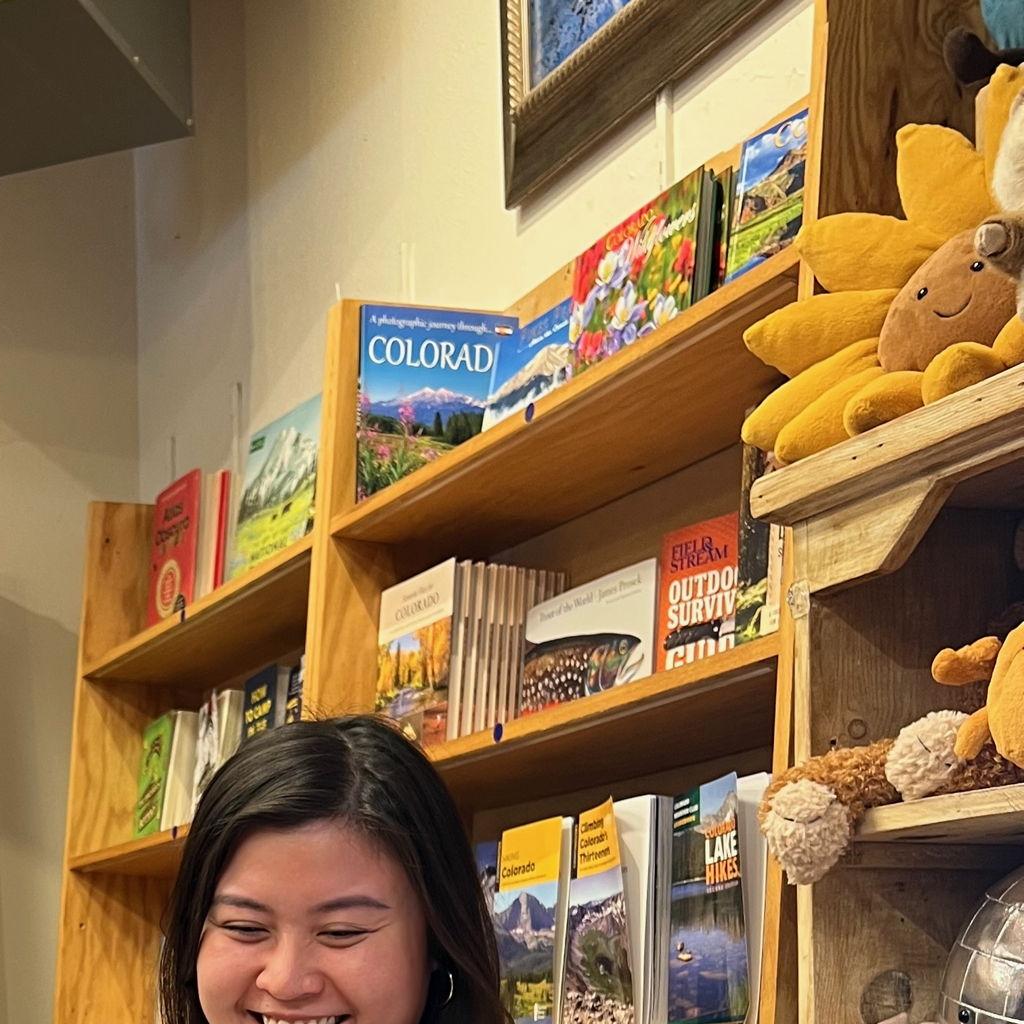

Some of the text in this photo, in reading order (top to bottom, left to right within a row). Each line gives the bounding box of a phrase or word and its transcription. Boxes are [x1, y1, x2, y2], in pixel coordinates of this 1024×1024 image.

[368, 335, 495, 373] COLORAD
[670, 544, 728, 574] STREAM
[668, 565, 739, 605] OUTDO
[666, 589, 737, 630] SURVIV
[705, 830, 738, 866] LAKE
[501, 860, 536, 879] Colorado
[705, 857, 740, 885] HIKES
